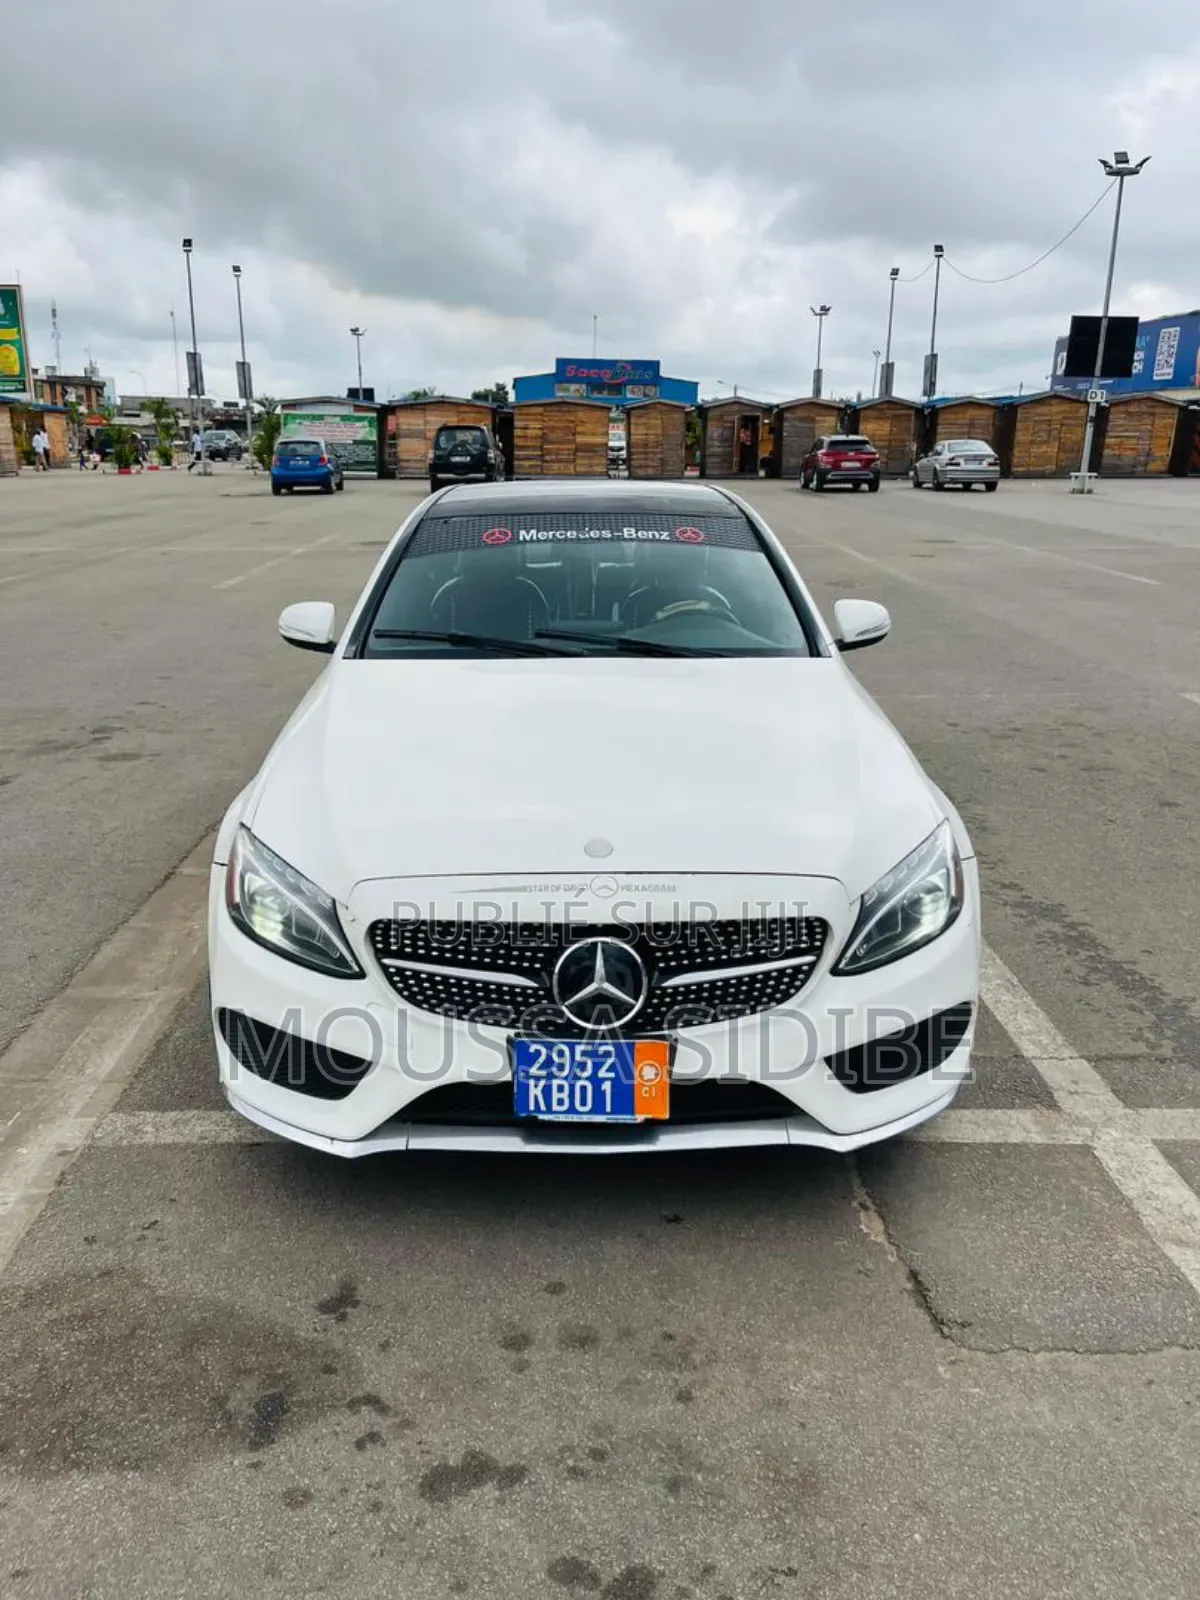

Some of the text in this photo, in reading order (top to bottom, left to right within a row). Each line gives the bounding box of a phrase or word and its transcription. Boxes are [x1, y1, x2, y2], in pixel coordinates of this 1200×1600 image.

[519, 527, 671, 541] Mercedes-Benz
[528, 1043, 616, 1078] 2952
[528, 1079, 613, 1112] KB01
[642, 1087, 656, 1097] CI
